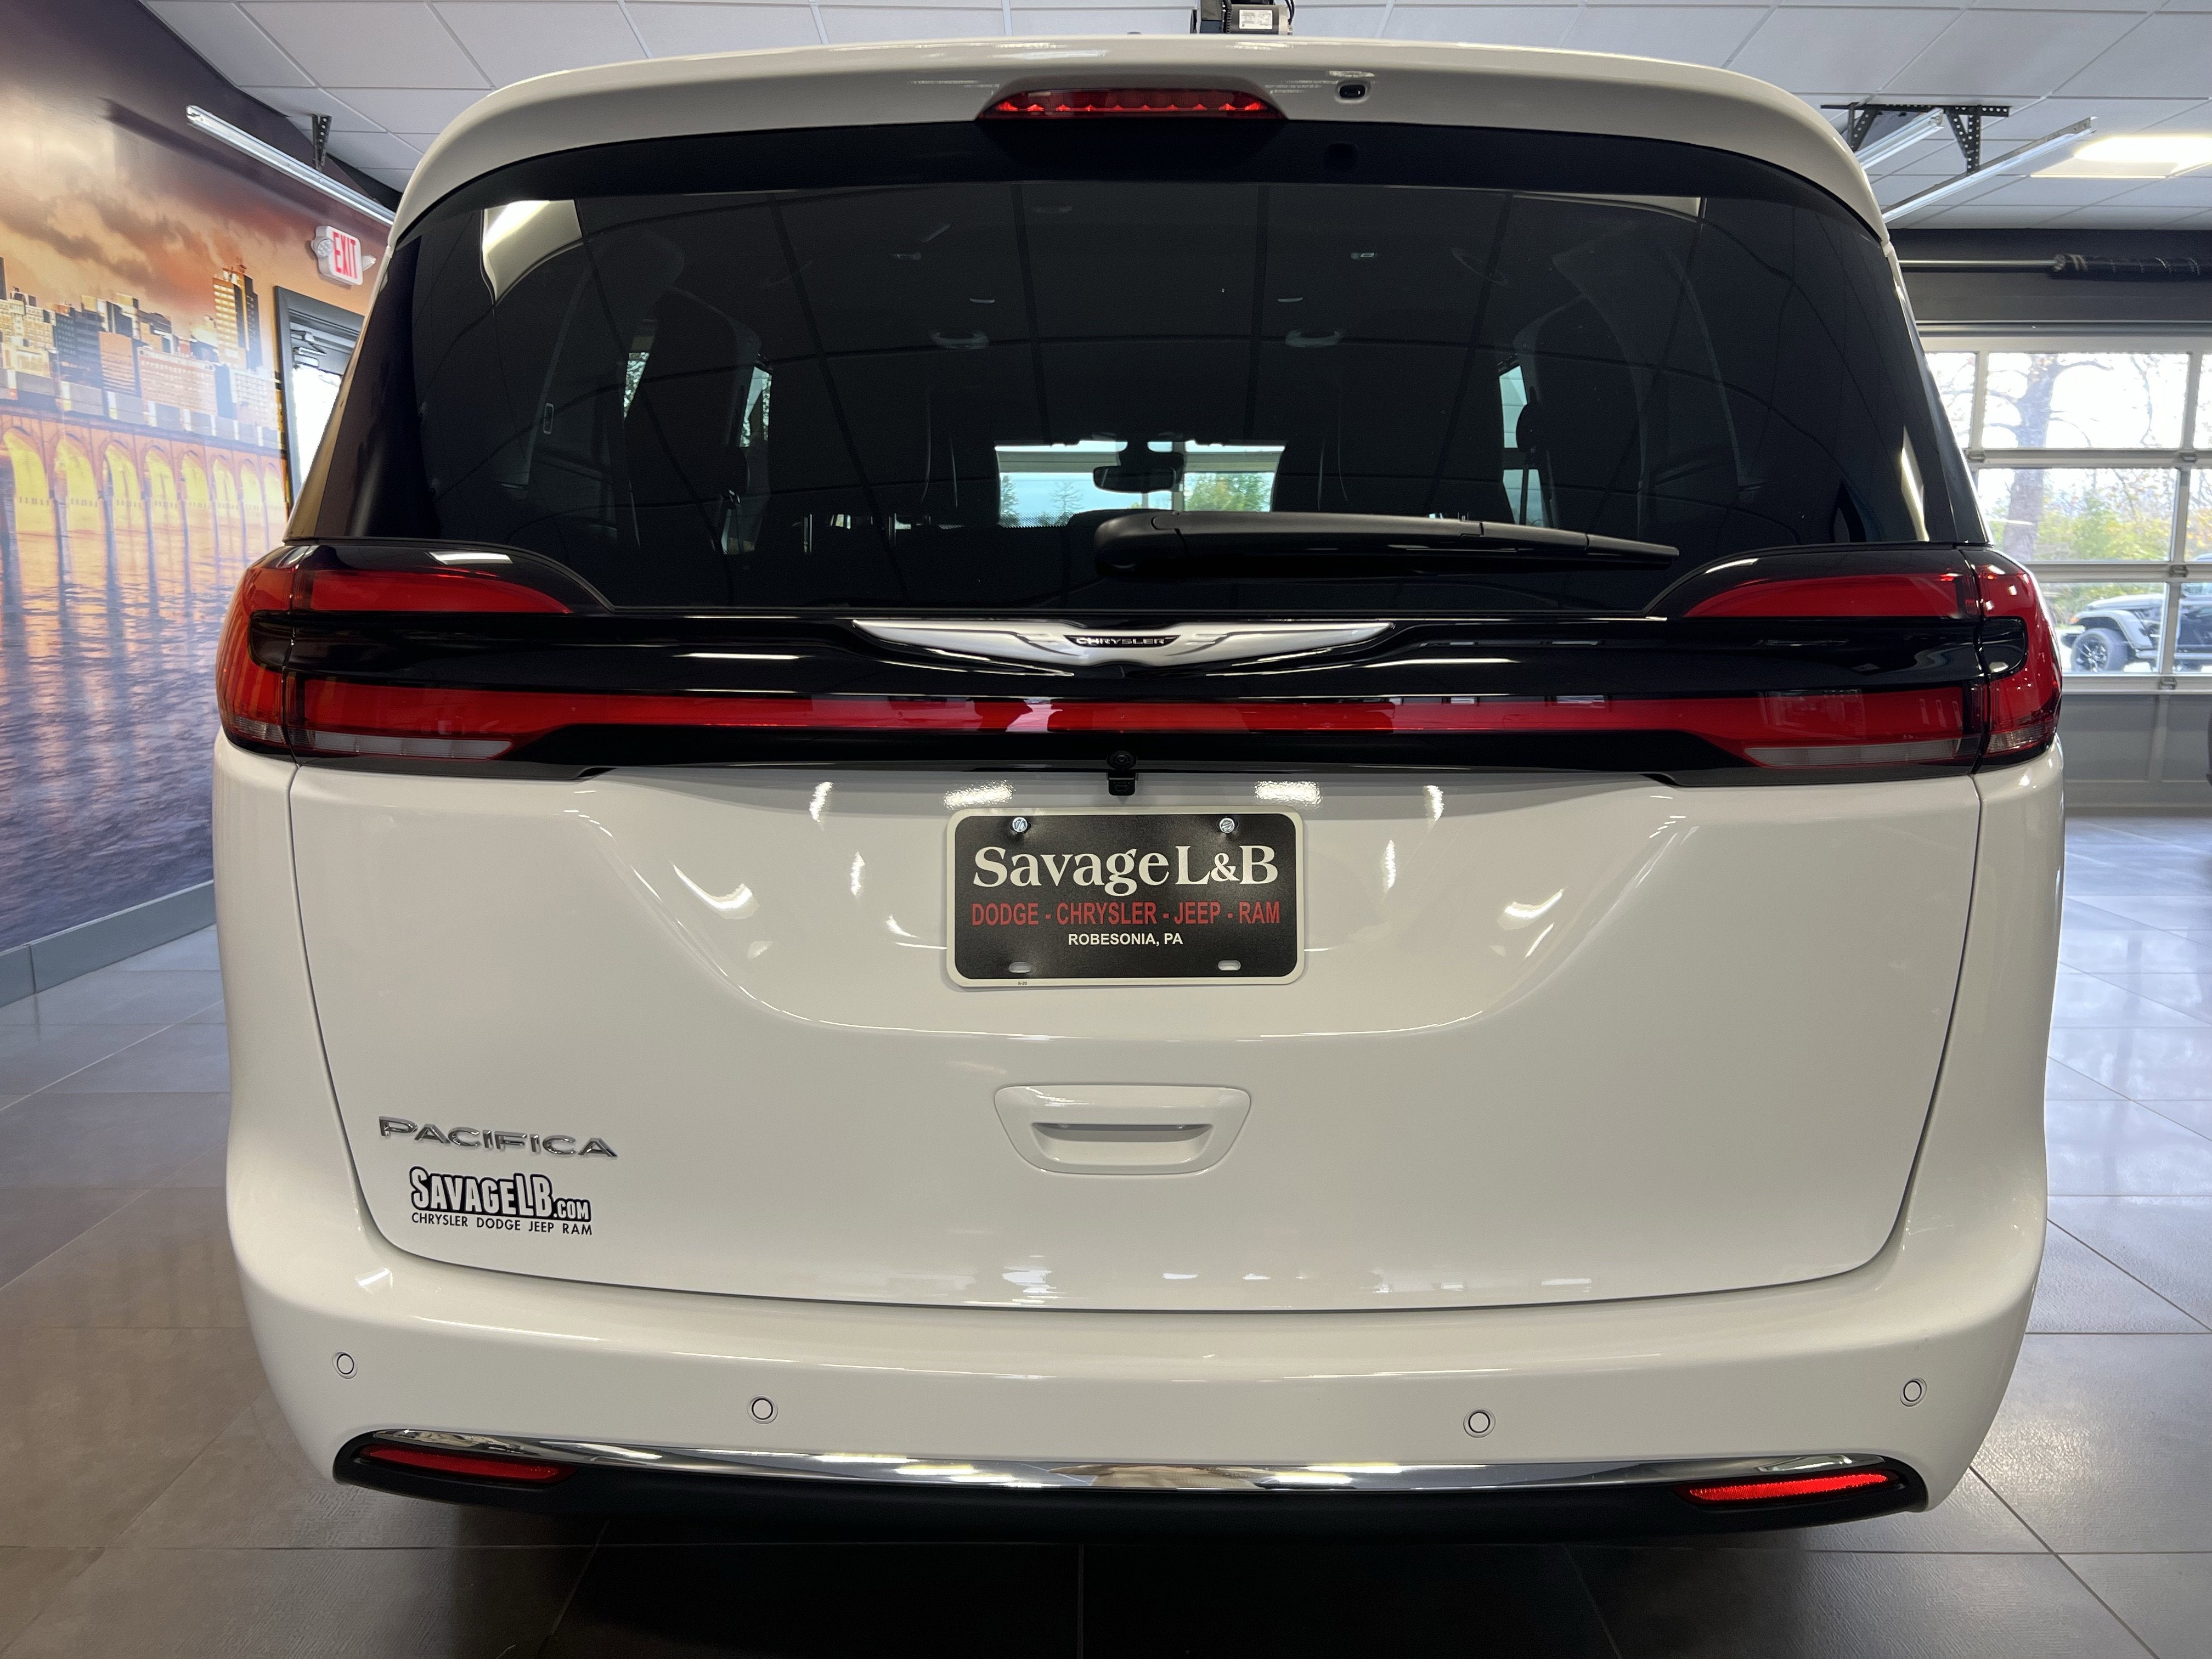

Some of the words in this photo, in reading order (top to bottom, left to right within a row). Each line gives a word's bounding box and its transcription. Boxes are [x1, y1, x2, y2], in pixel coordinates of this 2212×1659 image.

[333, 231, 358, 280] EXIT
[1076, 637, 1165, 646] CHRYSLER
[973, 846, 1170, 897] Savage
[1175, 845, 1278, 885] L&B
[972, 902, 1039, 926] DODGE
[1056, 902, 1157, 925] CHRYSLER
[1174, 901, 1221, 924] JEEP
[1239, 901, 1280, 924] RAM
[1068, 934, 1159, 947] ROBESONIA,
[1164, 933, 1183, 945] PA
[379, 1116, 618, 1158] PACIFICA
[411, 1212, 469, 1227] CHRYSLER
[477, 1217, 521, 1231] DODGE
[528, 1221, 555, 1233] JEEP
[562, 1223, 592, 1235] RAM
